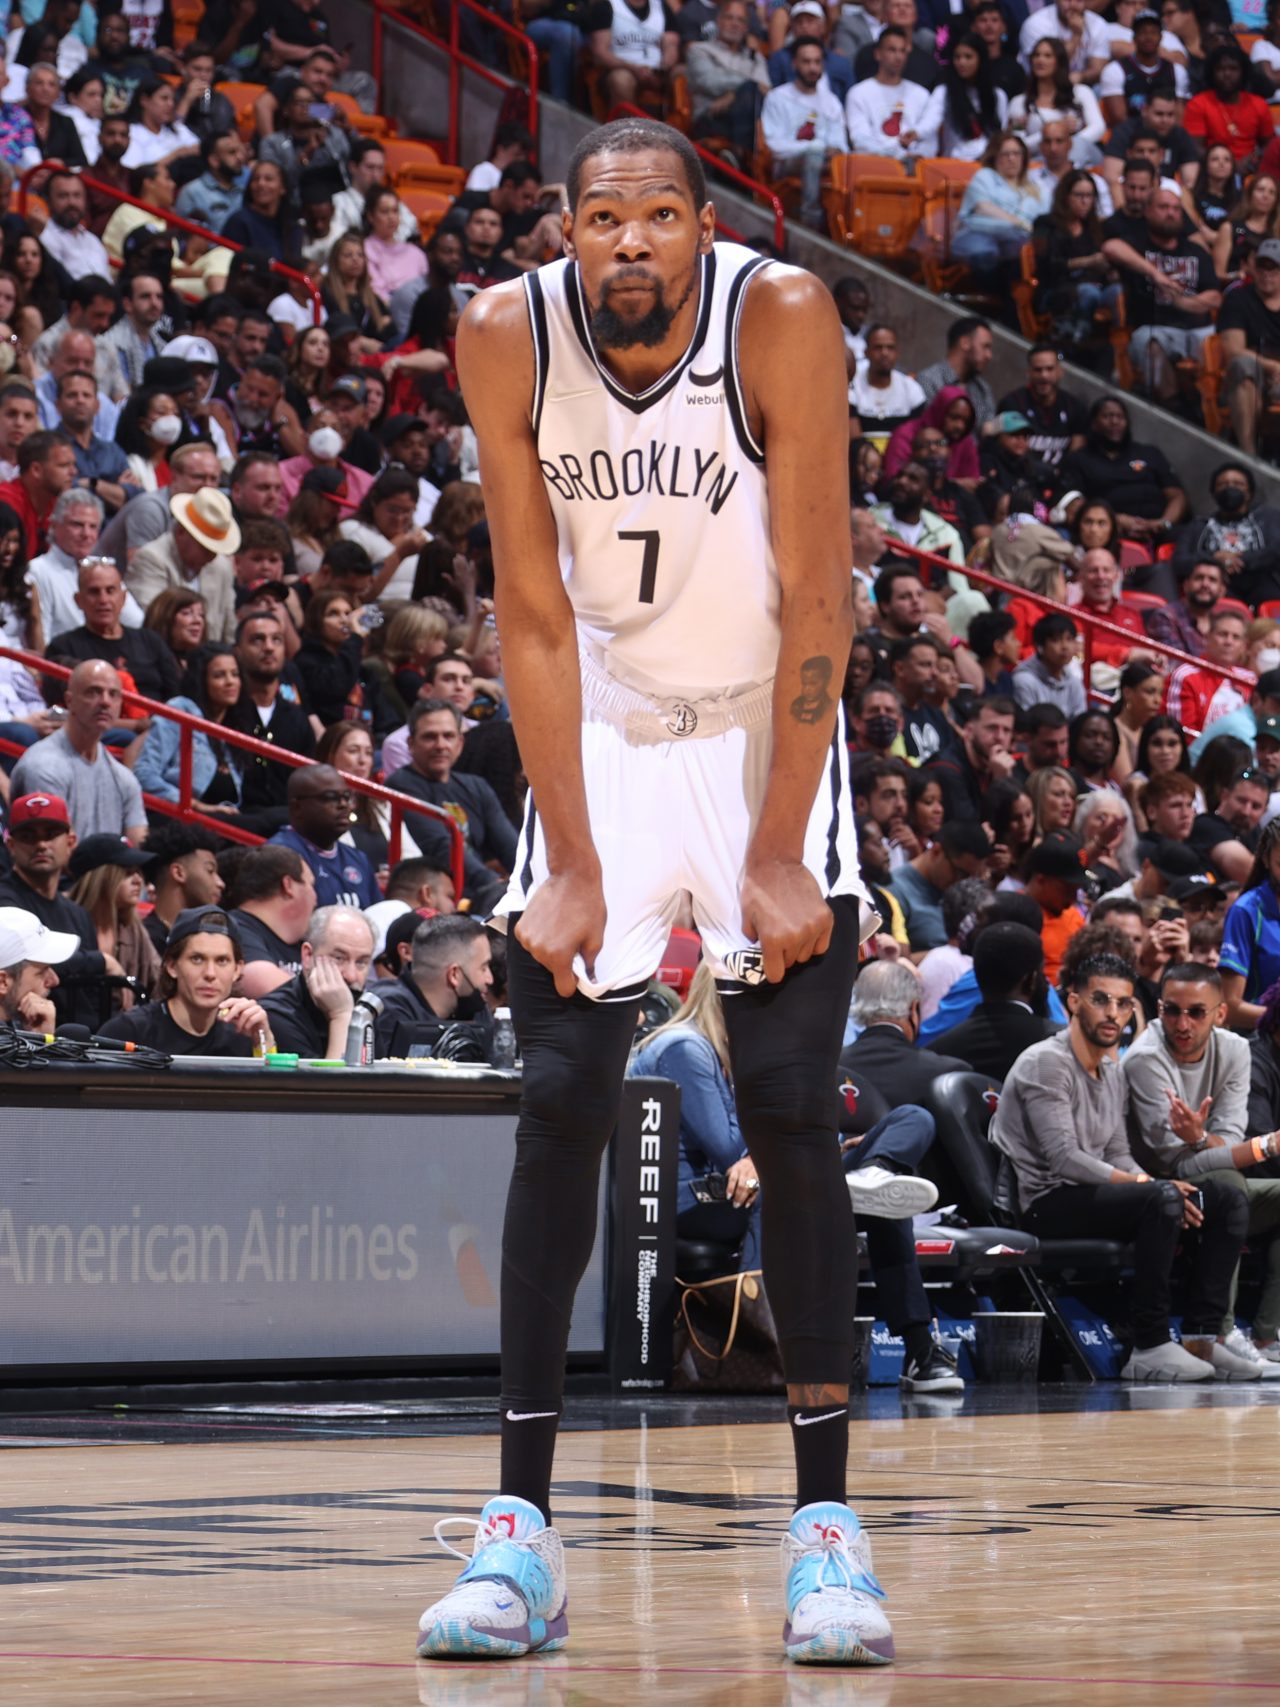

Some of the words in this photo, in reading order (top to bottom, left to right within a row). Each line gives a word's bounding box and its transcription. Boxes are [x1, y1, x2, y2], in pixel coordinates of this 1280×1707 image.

[540, 440, 739, 516] BROOKLYN
[617, 530, 661, 605] 7
[639, 1097, 662, 1224] REEF
[235, 1205, 419, 1283] Airlines
[650, 1249, 658, 1278] THE
[640, 1249, 652, 1365] NEIGHBORHOOD
